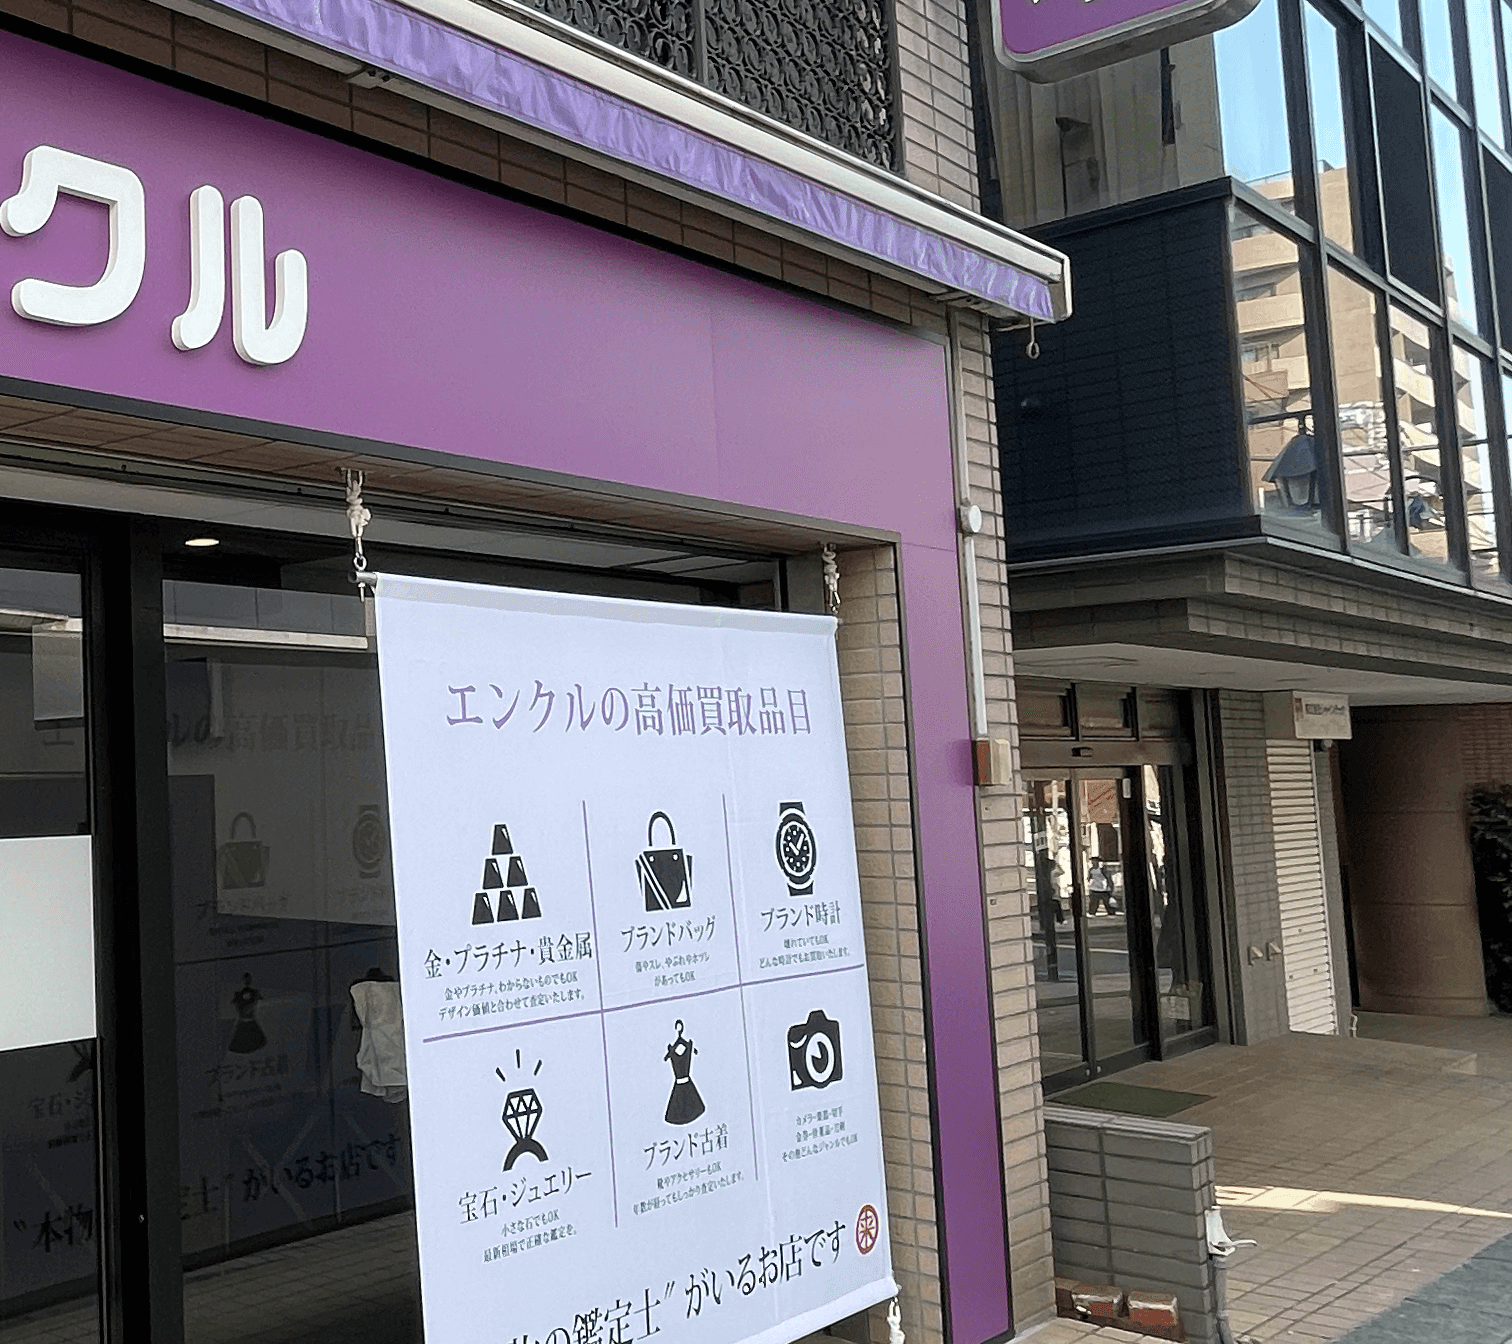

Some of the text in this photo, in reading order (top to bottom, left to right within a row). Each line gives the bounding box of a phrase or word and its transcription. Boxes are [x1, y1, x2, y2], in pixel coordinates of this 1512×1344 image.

[446, 680, 812, 737] エンクルの高価買取品目
[621, 915, 716, 953] ブランドバッグ
[761, 900, 841, 932] ブランド時計
[424, 932, 593, 979] 金・プラチナ・貴金属
[644, 1123, 728, 1171] ブランド古着
[459, 1166, 592, 1224] 宝石・ジュエリー
[501, 1209, 560, 1237] 小さな石でもOK
